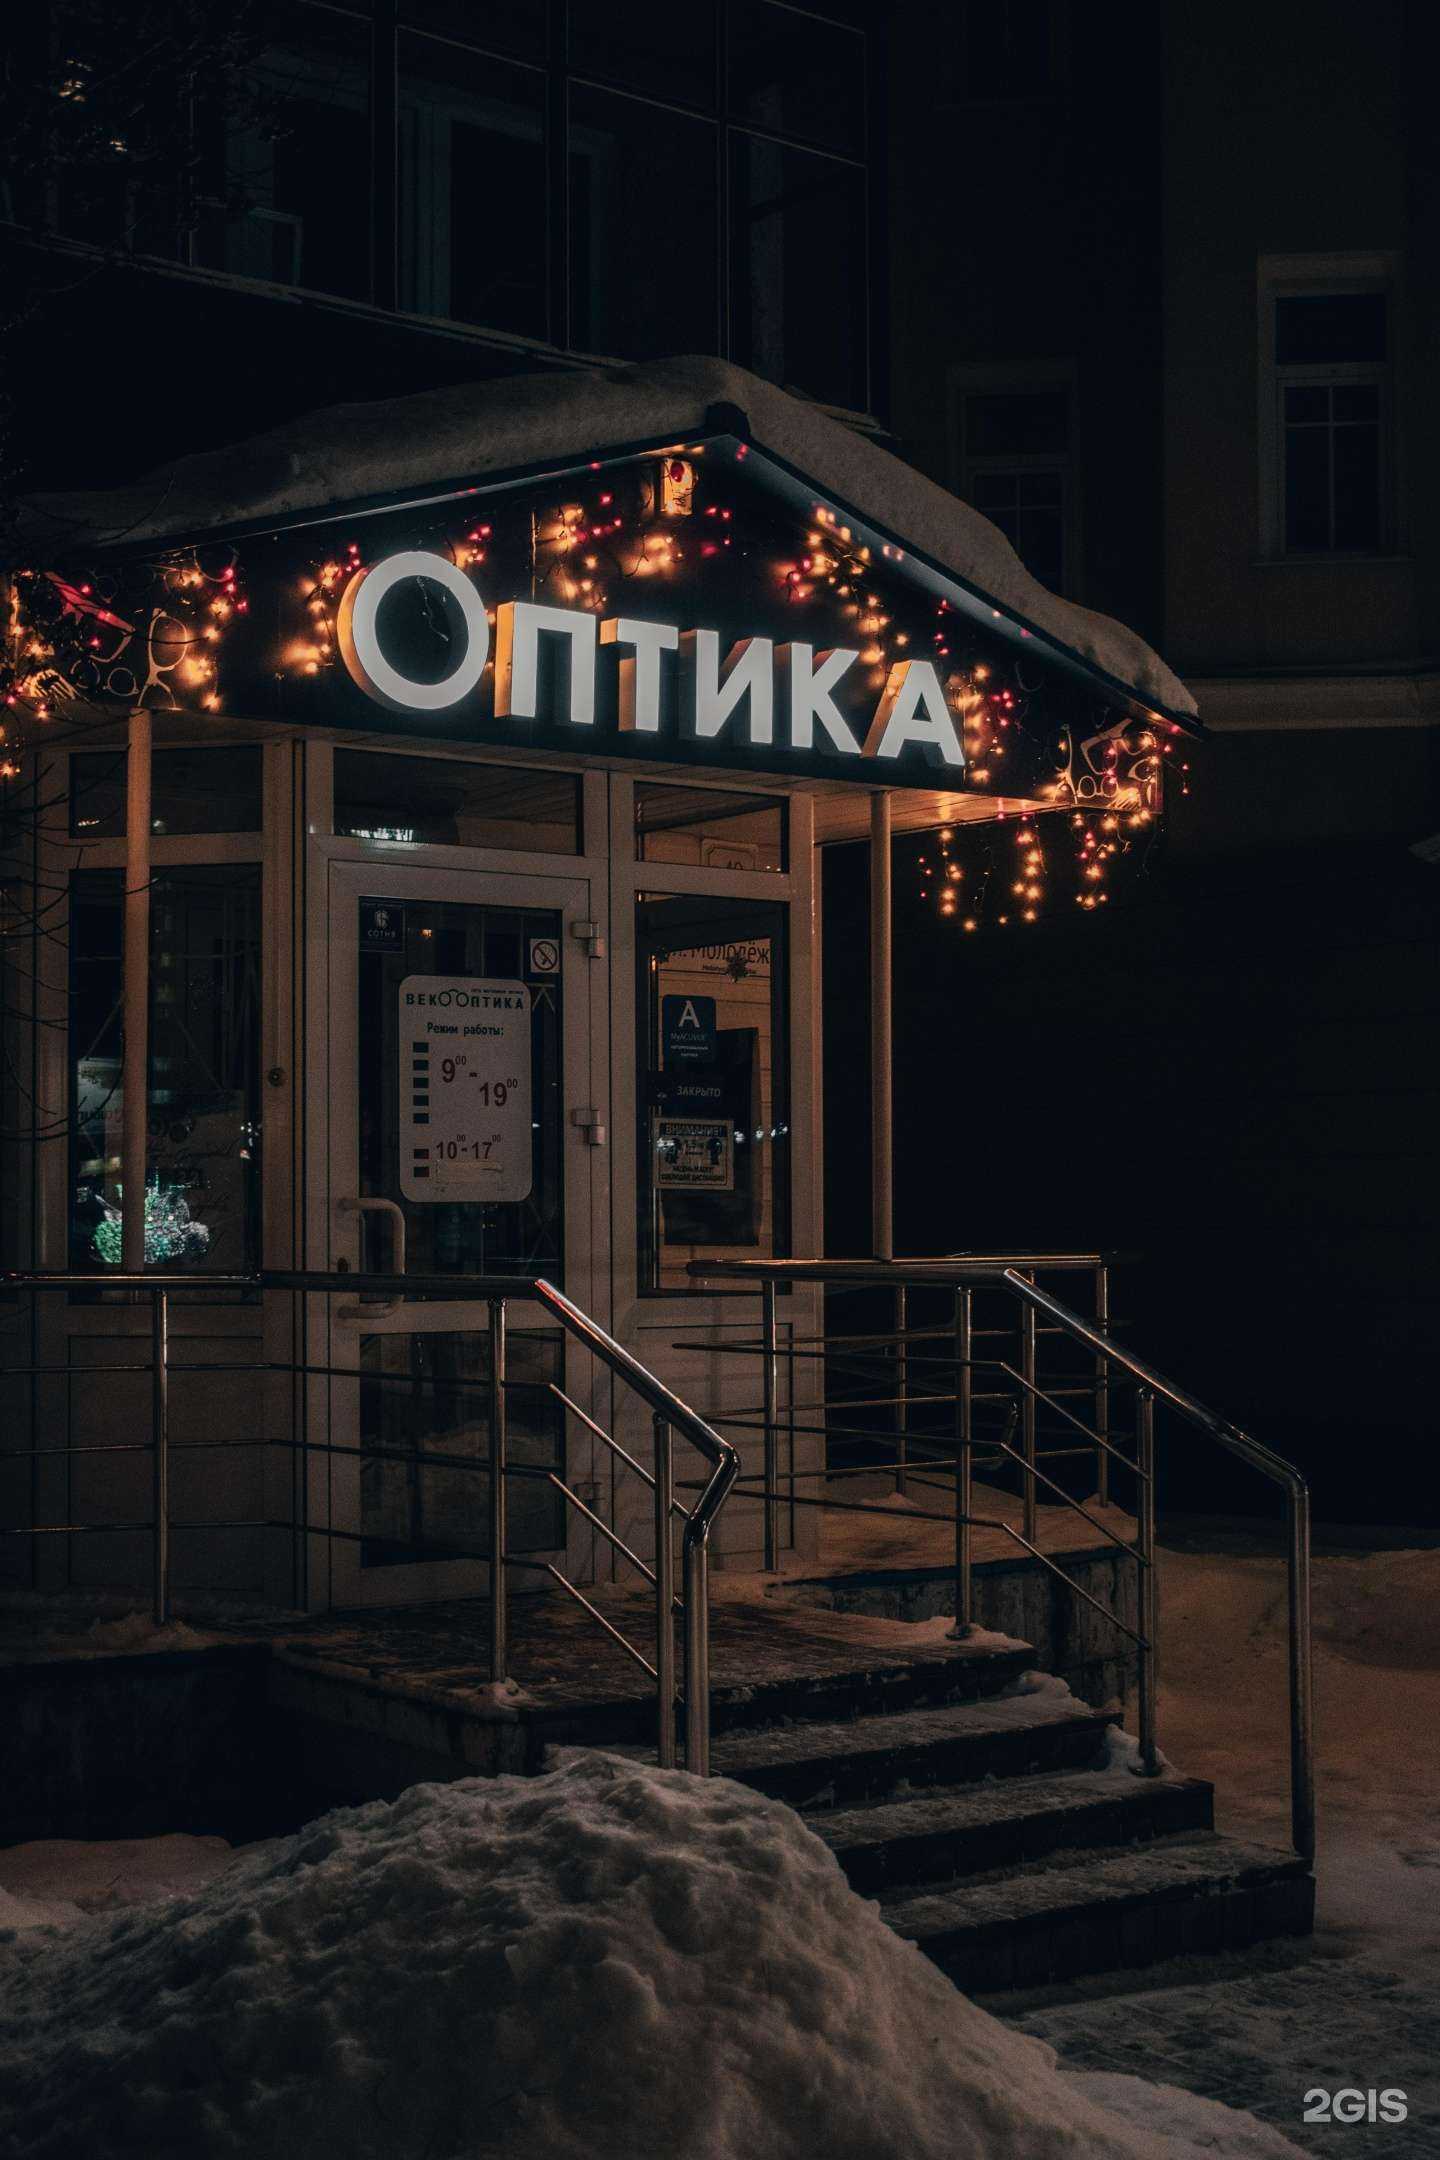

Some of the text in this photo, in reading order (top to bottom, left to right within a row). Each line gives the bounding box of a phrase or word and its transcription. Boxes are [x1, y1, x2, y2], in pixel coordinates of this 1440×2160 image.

[341, 551, 965, 767] ОПТИКА
[427, 1022, 504, 1037] Режим работы:
